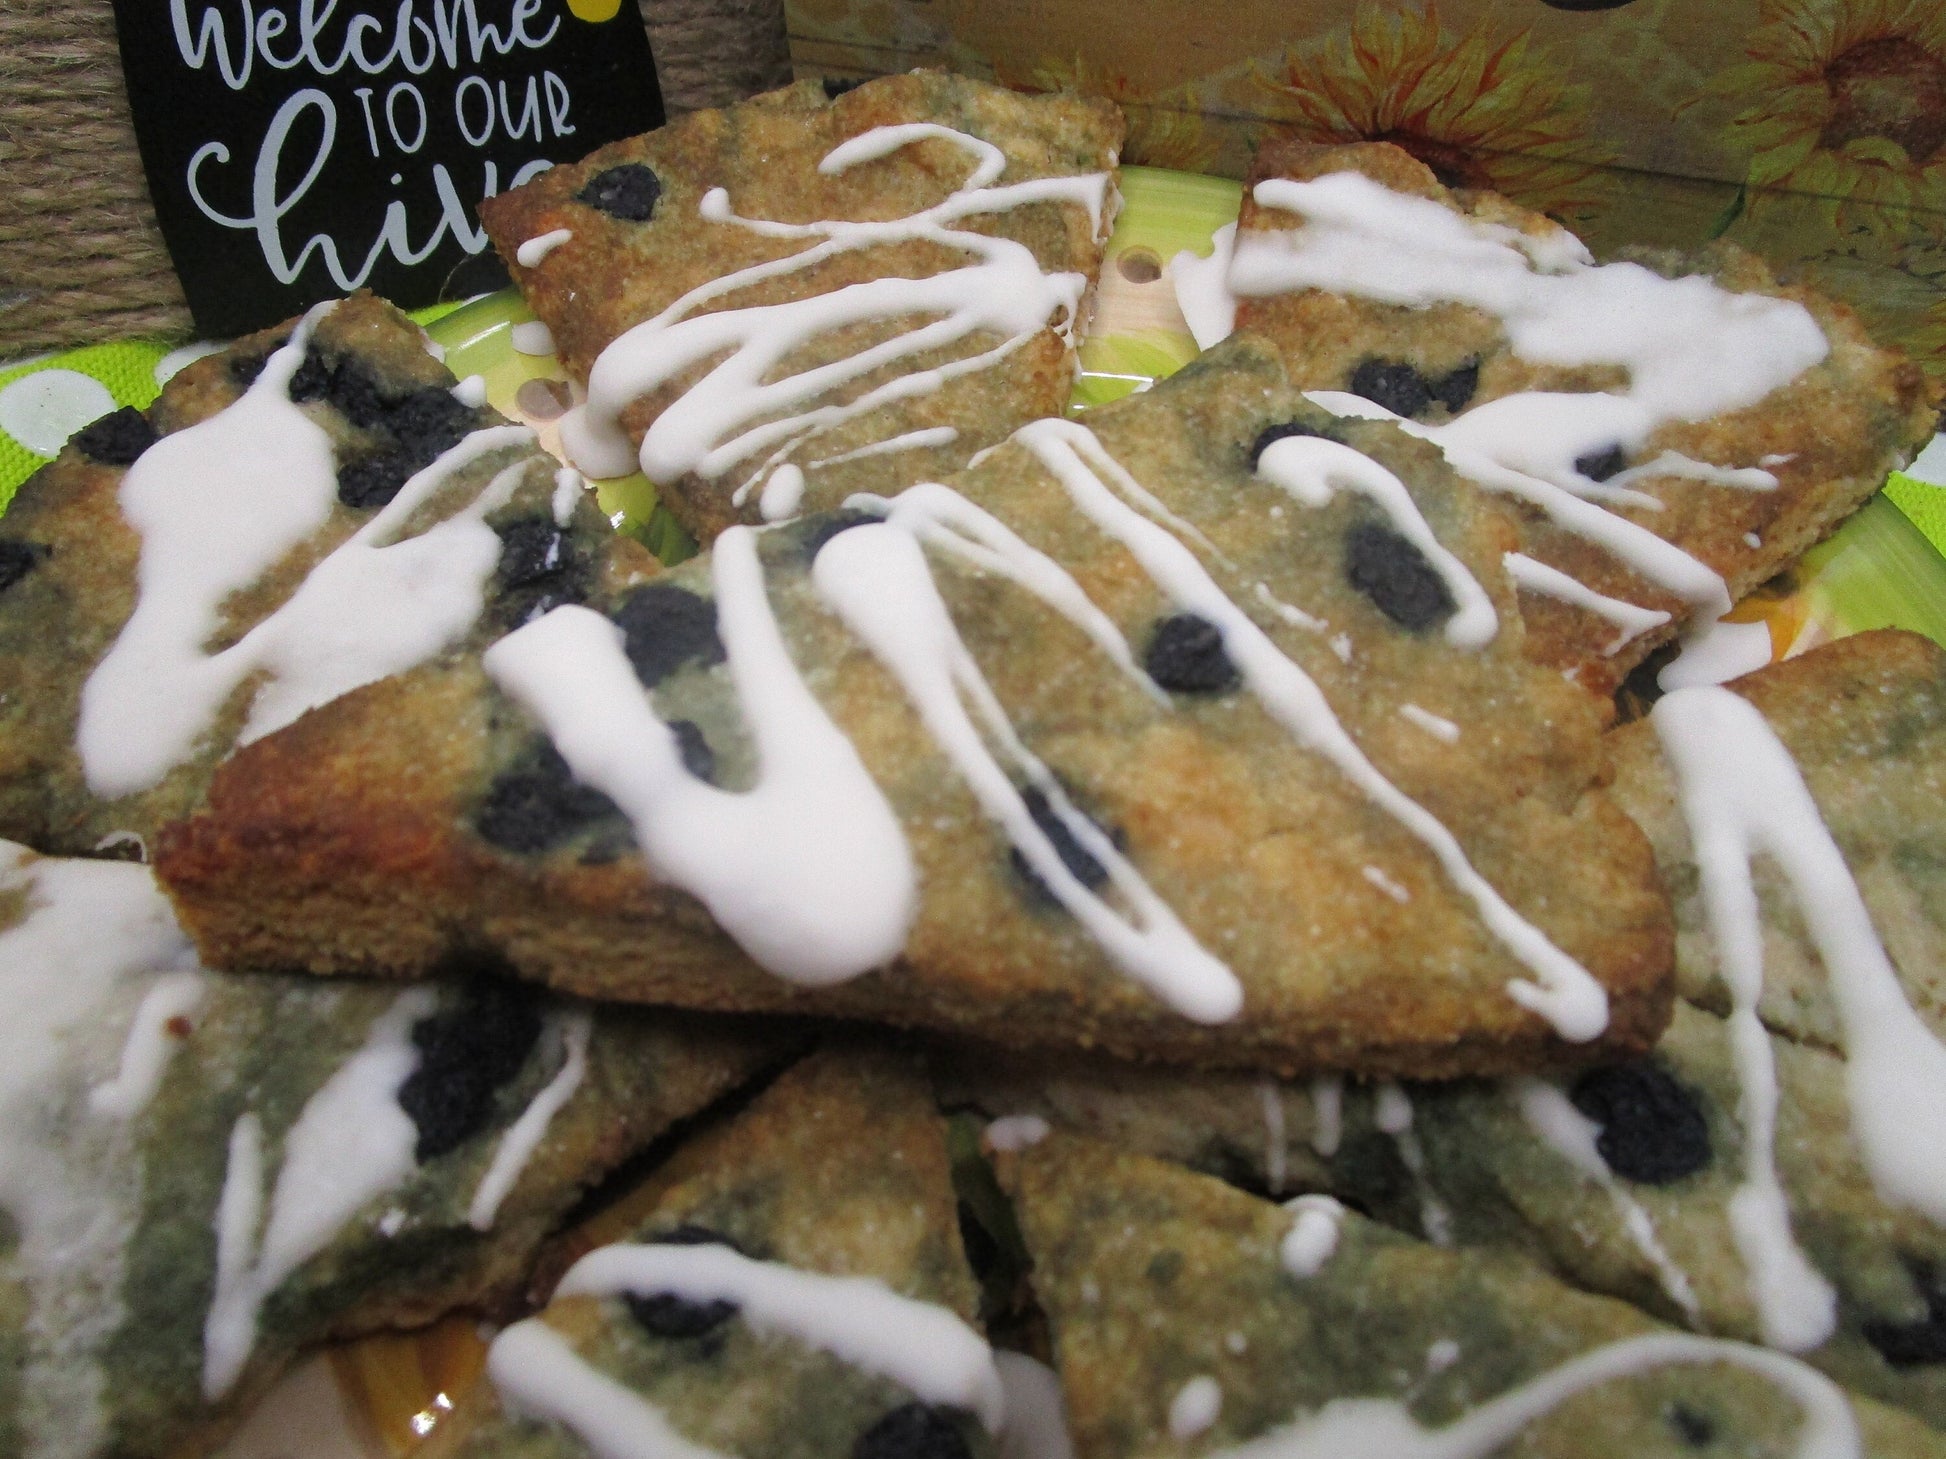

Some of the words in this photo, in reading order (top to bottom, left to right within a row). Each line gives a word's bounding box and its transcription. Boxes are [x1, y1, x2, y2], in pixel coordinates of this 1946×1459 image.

[171, 0, 561, 90] Welcome
[354, 82, 427, 157] TO
[455, 71, 576, 147] OUR
